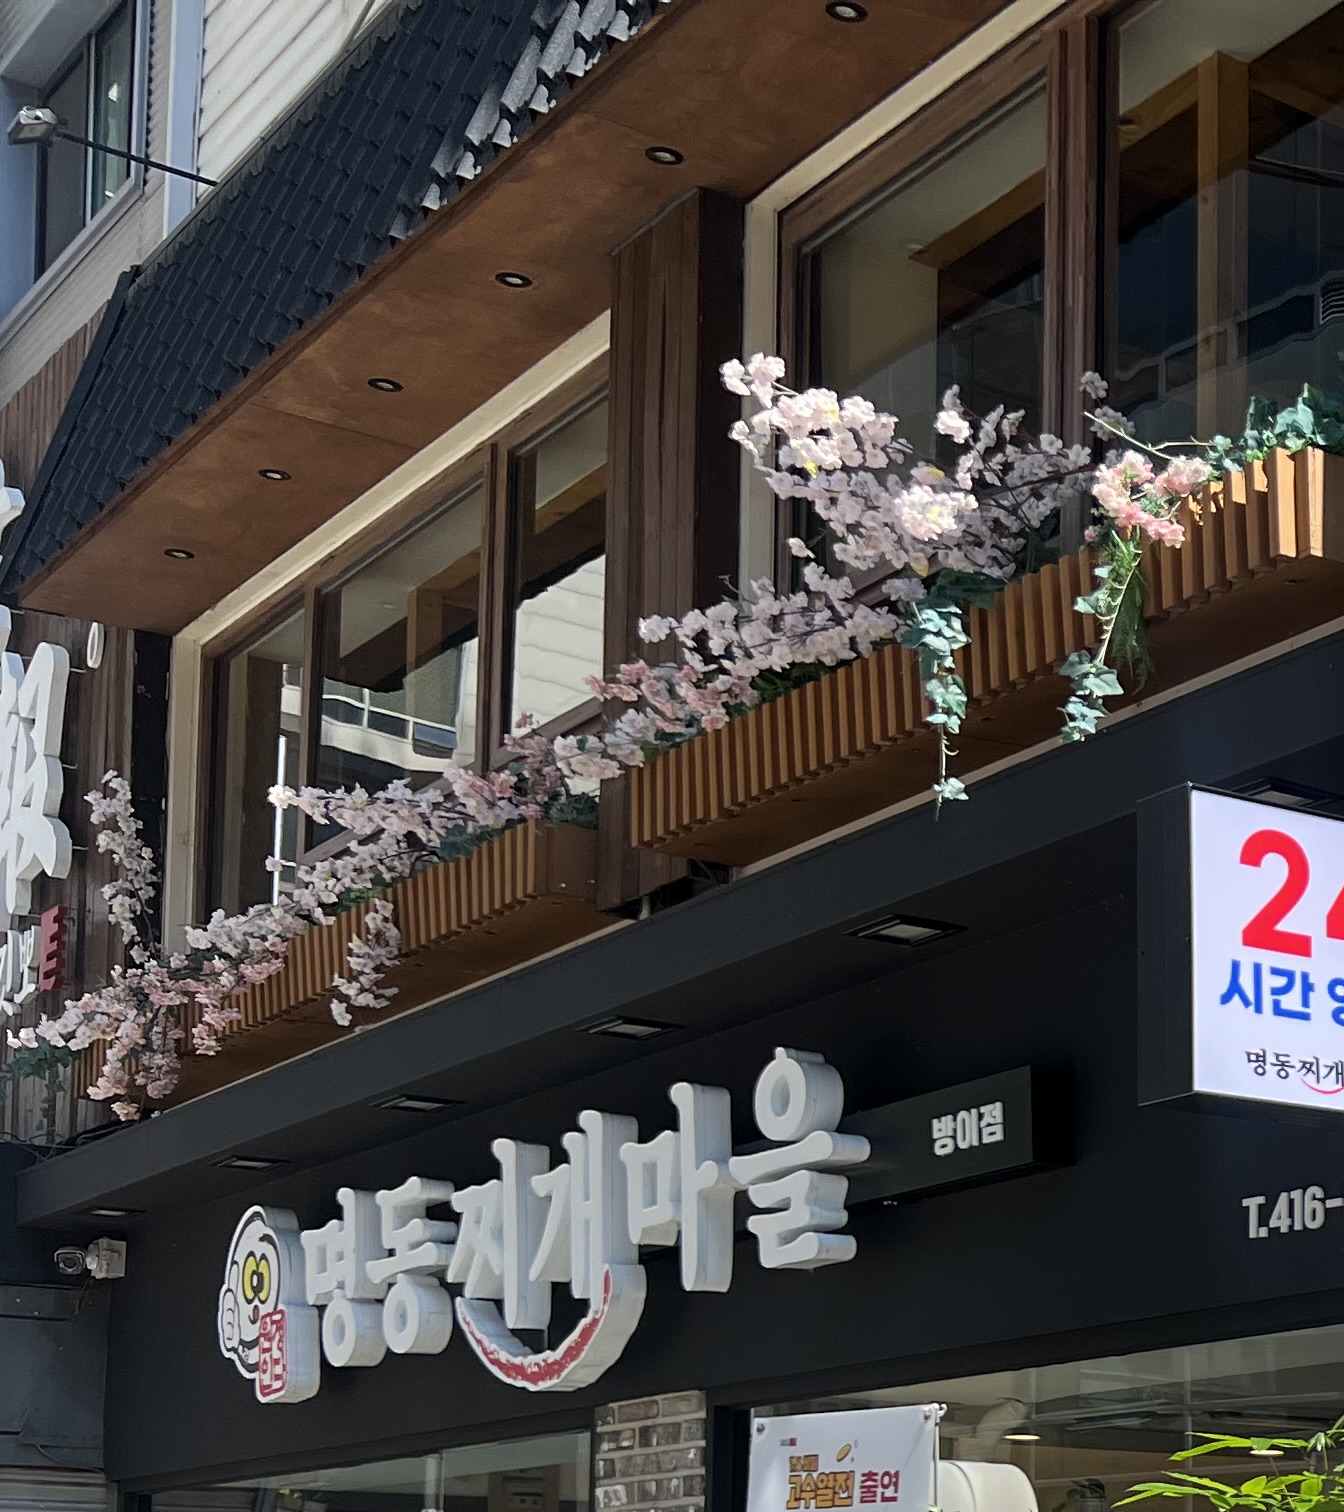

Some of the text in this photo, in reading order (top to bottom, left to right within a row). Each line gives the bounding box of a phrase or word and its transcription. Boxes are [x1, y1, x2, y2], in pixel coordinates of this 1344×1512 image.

[1218, 957, 1316, 1022] 시간
[931, 1100, 1005, 1157] 방이점
[300, 1046, 871, 1369] 명동찌개마을
[859, 1469, 900, 1503] 출연
